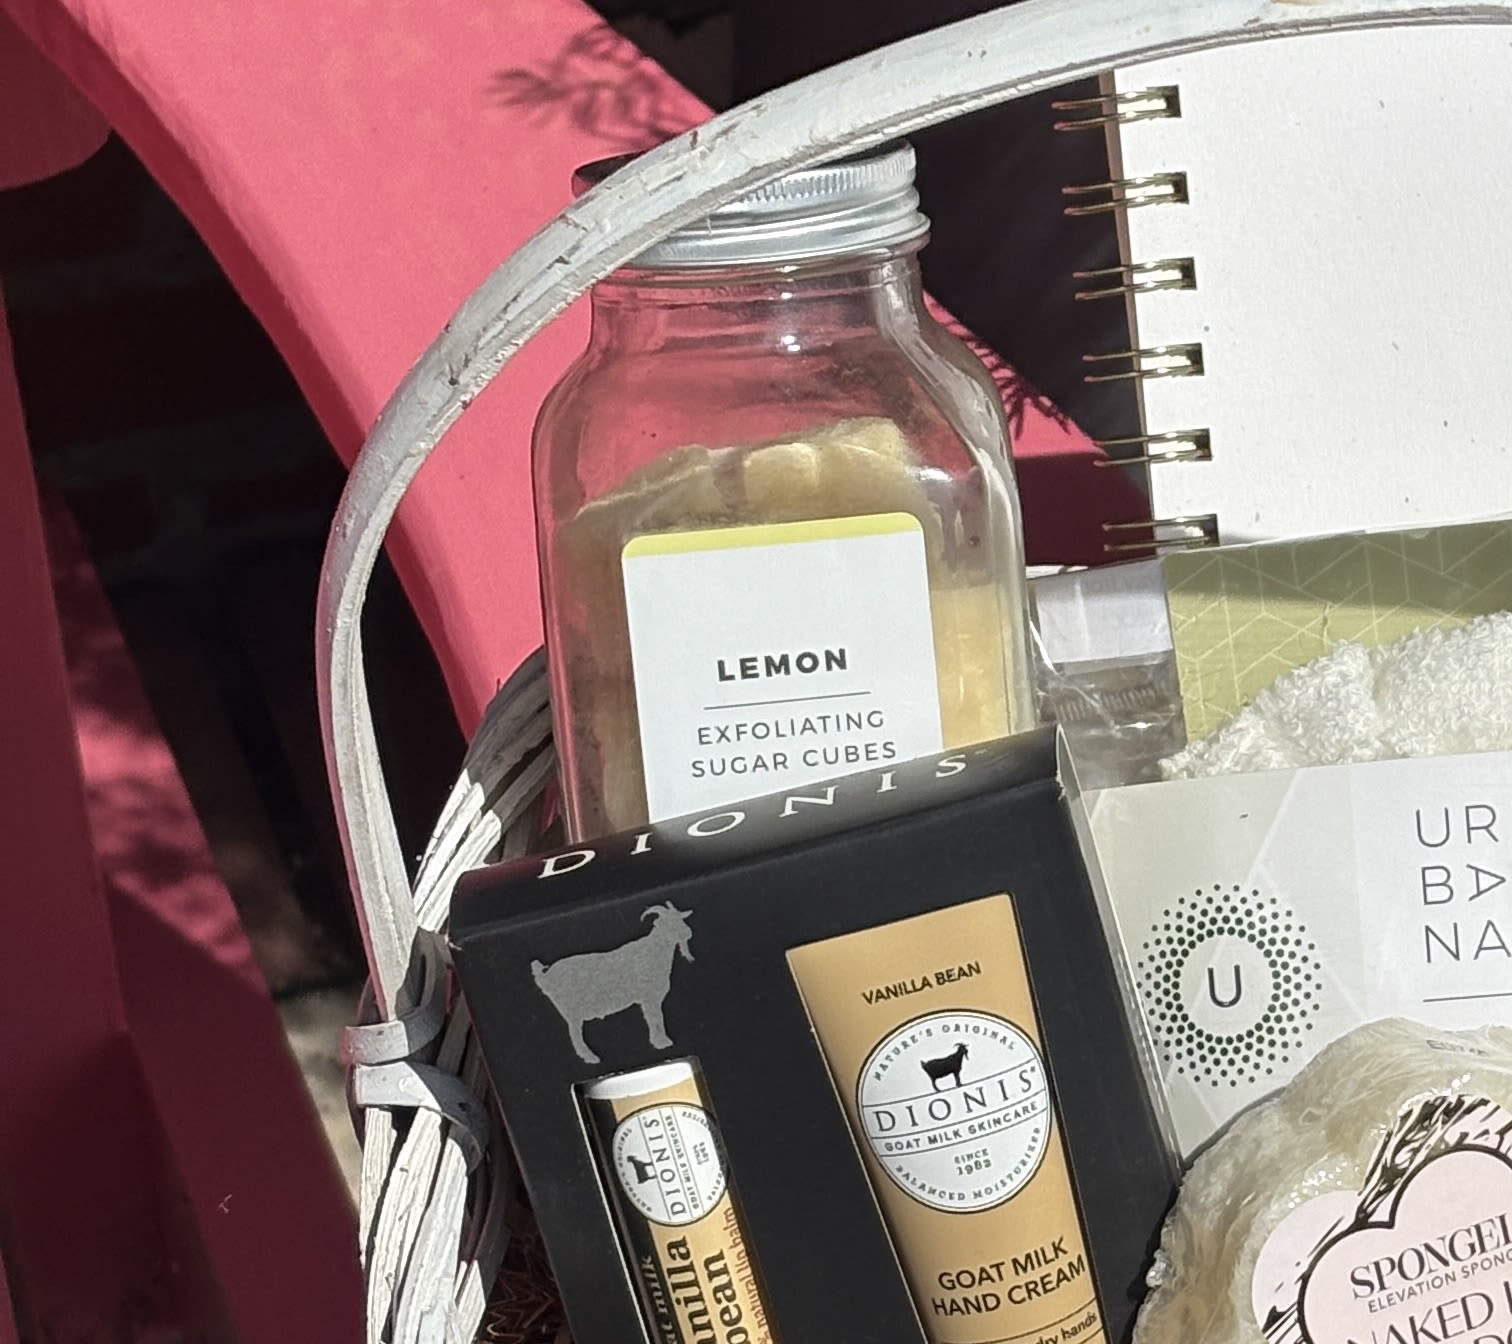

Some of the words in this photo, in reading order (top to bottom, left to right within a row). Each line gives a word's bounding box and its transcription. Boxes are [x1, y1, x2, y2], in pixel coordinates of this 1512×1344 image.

[717, 648, 848, 682] LEMON
[698, 710, 885, 745] EXFOLIATING
[691, 752, 789, 778] SUGAR
[802, 741, 897, 767] CUBES
[537, 754, 967, 880] DIONIS
[1415, 804, 1499, 848] UR
[1424, 919, 1512, 964] NA
[861, 975, 934, 1006] VANILLA
[935, 961, 982, 987] BEAN
[1207, 964, 1243, 1008] U
[872, 1069, 1033, 1133] DIONIS
[884, 1138, 922, 1152] GOAT
[927, 1128, 962, 1145] MILK
[967, 1100, 1038, 1136] SKINCARE
[644, 1118, 688, 1216] DIONIS
[931, 1292, 1001, 1317] HAND
[1007, 1254, 1087, 1305] CREAM
[938, 1261, 1006, 1291] GOAT
[1011, 1235, 1069, 1277] MILK
[1368, 1270, 1457, 1314] ELEVATION
[1061, 1311, 1098, 1342] hands
